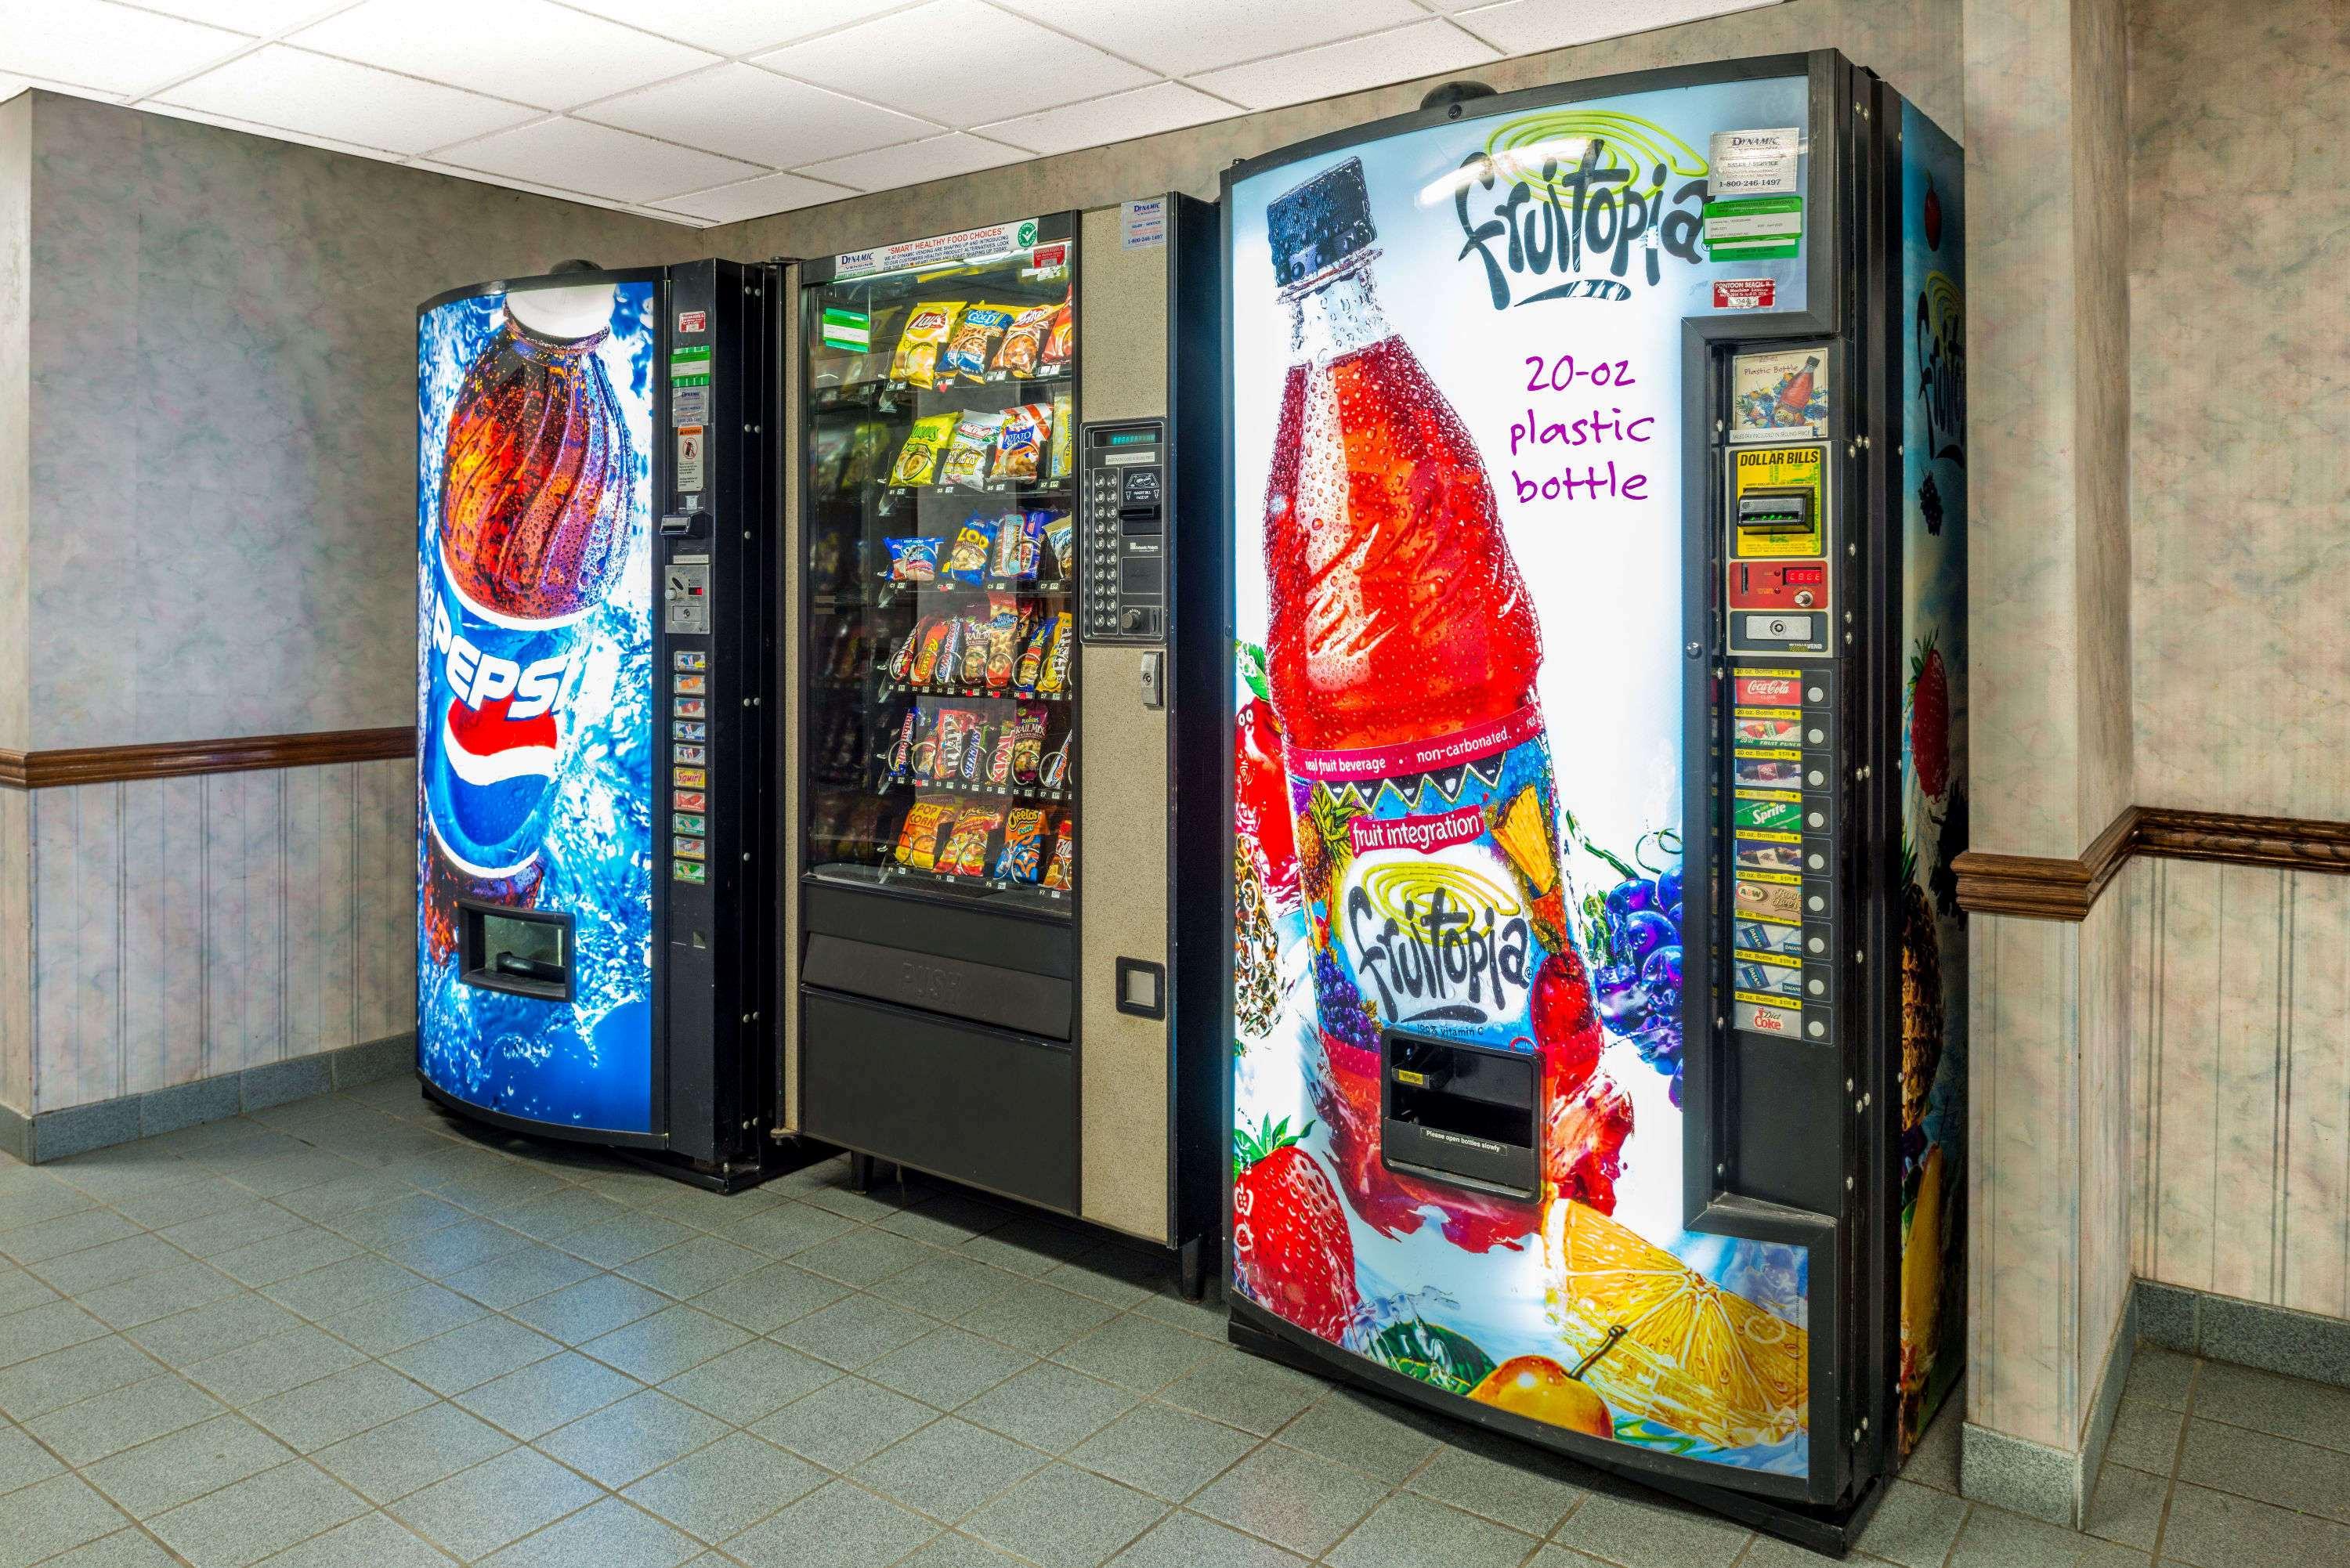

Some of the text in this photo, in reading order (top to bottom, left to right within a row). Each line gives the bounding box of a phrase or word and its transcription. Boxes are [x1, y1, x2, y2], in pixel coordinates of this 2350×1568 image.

[1731, 137, 1780, 146] DYNAMIC
[1718, 179, 1781, 188] 1-800-246-1497
[1133, 202, 1160, 212] DYNAMIC
[915, 237, 945, 250] HEALTHY
[947, 232, 968, 244] FOOD
[943, 242, 963, 251] SHAPING
[980, 235, 1009, 244] INTRODUCING
[841, 252, 874, 265] DYNAMIC
[898, 255, 924, 264] CUSTOMERS
[967, 313, 996, 323] GOLD
[1526, 355, 1636, 392] 20-oz
[1744, 364, 1799, 376] Plastic Bottle
[1004, 431, 1032, 443] POTATO
[1510, 407, 1655, 457] plastic
[1740, 451, 1819, 467] DOLLAR BILLS
[1511, 461, 1648, 504] bottle
[991, 616, 1018, 629] DIAMOND
[996, 614, 1011, 623] BLUE
[432, 593, 585, 718] PEPSI
[1014, 723, 1046, 736] TRAIL MIX
[964, 728, 981, 779] SNICKERS
[992, 729, 1015, 782] TWIX
[1305, 726, 1509, 775] real fruit beverage non-carbonated
[678, 771, 702, 783] Squirt
[916, 804, 938, 815] POP
[1752, 803, 1787, 825] Sprite
[909, 814, 937, 827] CORN
[1007, 807, 1039, 829] Cheetos
[1353, 822, 1383, 852] fruit
[1755, 953, 1773, 962] Bottle
[1755, 995, 1774, 1005] Bottle
[1763, 1009, 1781, 1021] Diet
[1755, 1015, 1782, 1031] Coke
[1416, 1024, 1485, 1038] 100% vitamin C
[1426, 1129, 1500, 1152] Please open bottles slowly
